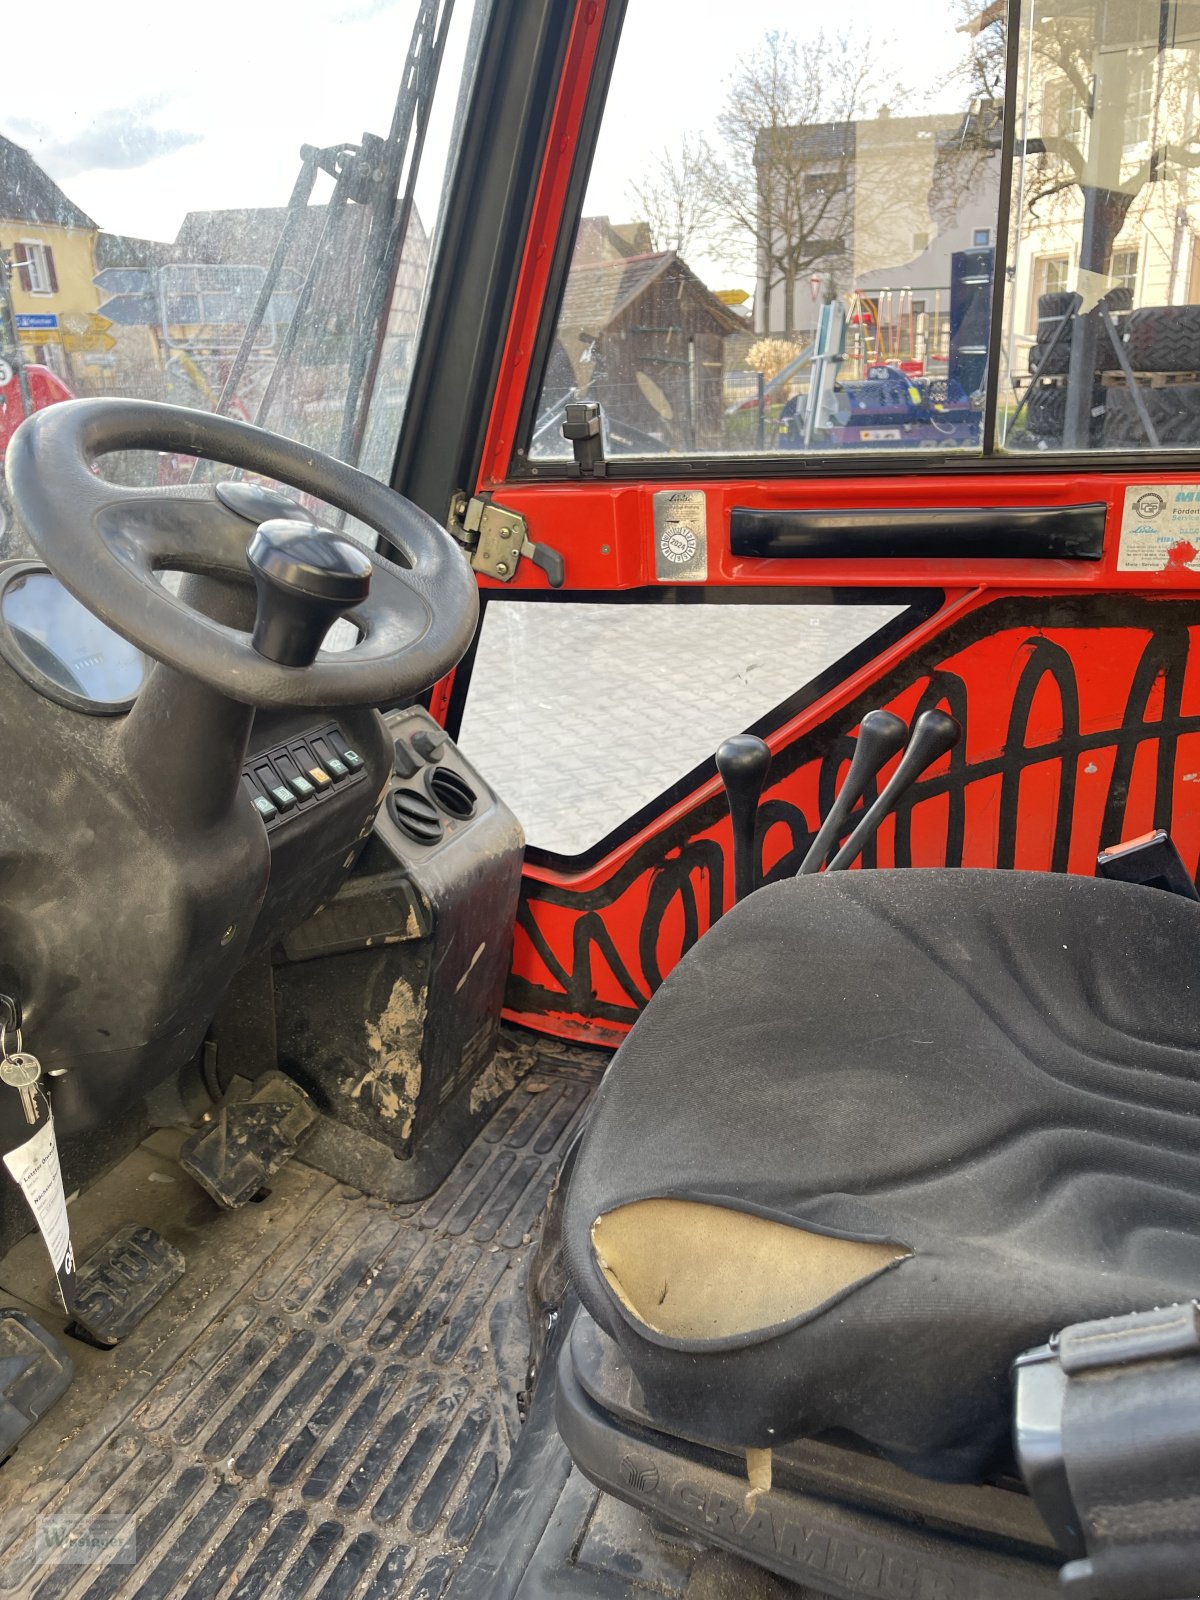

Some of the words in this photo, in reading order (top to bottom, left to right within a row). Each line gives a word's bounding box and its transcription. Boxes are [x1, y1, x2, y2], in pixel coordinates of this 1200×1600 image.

[670, 538, 686, 551] 2024
[23, 1164, 43, 1183] Letzter
[75, 1226, 166, 1325] STOP
